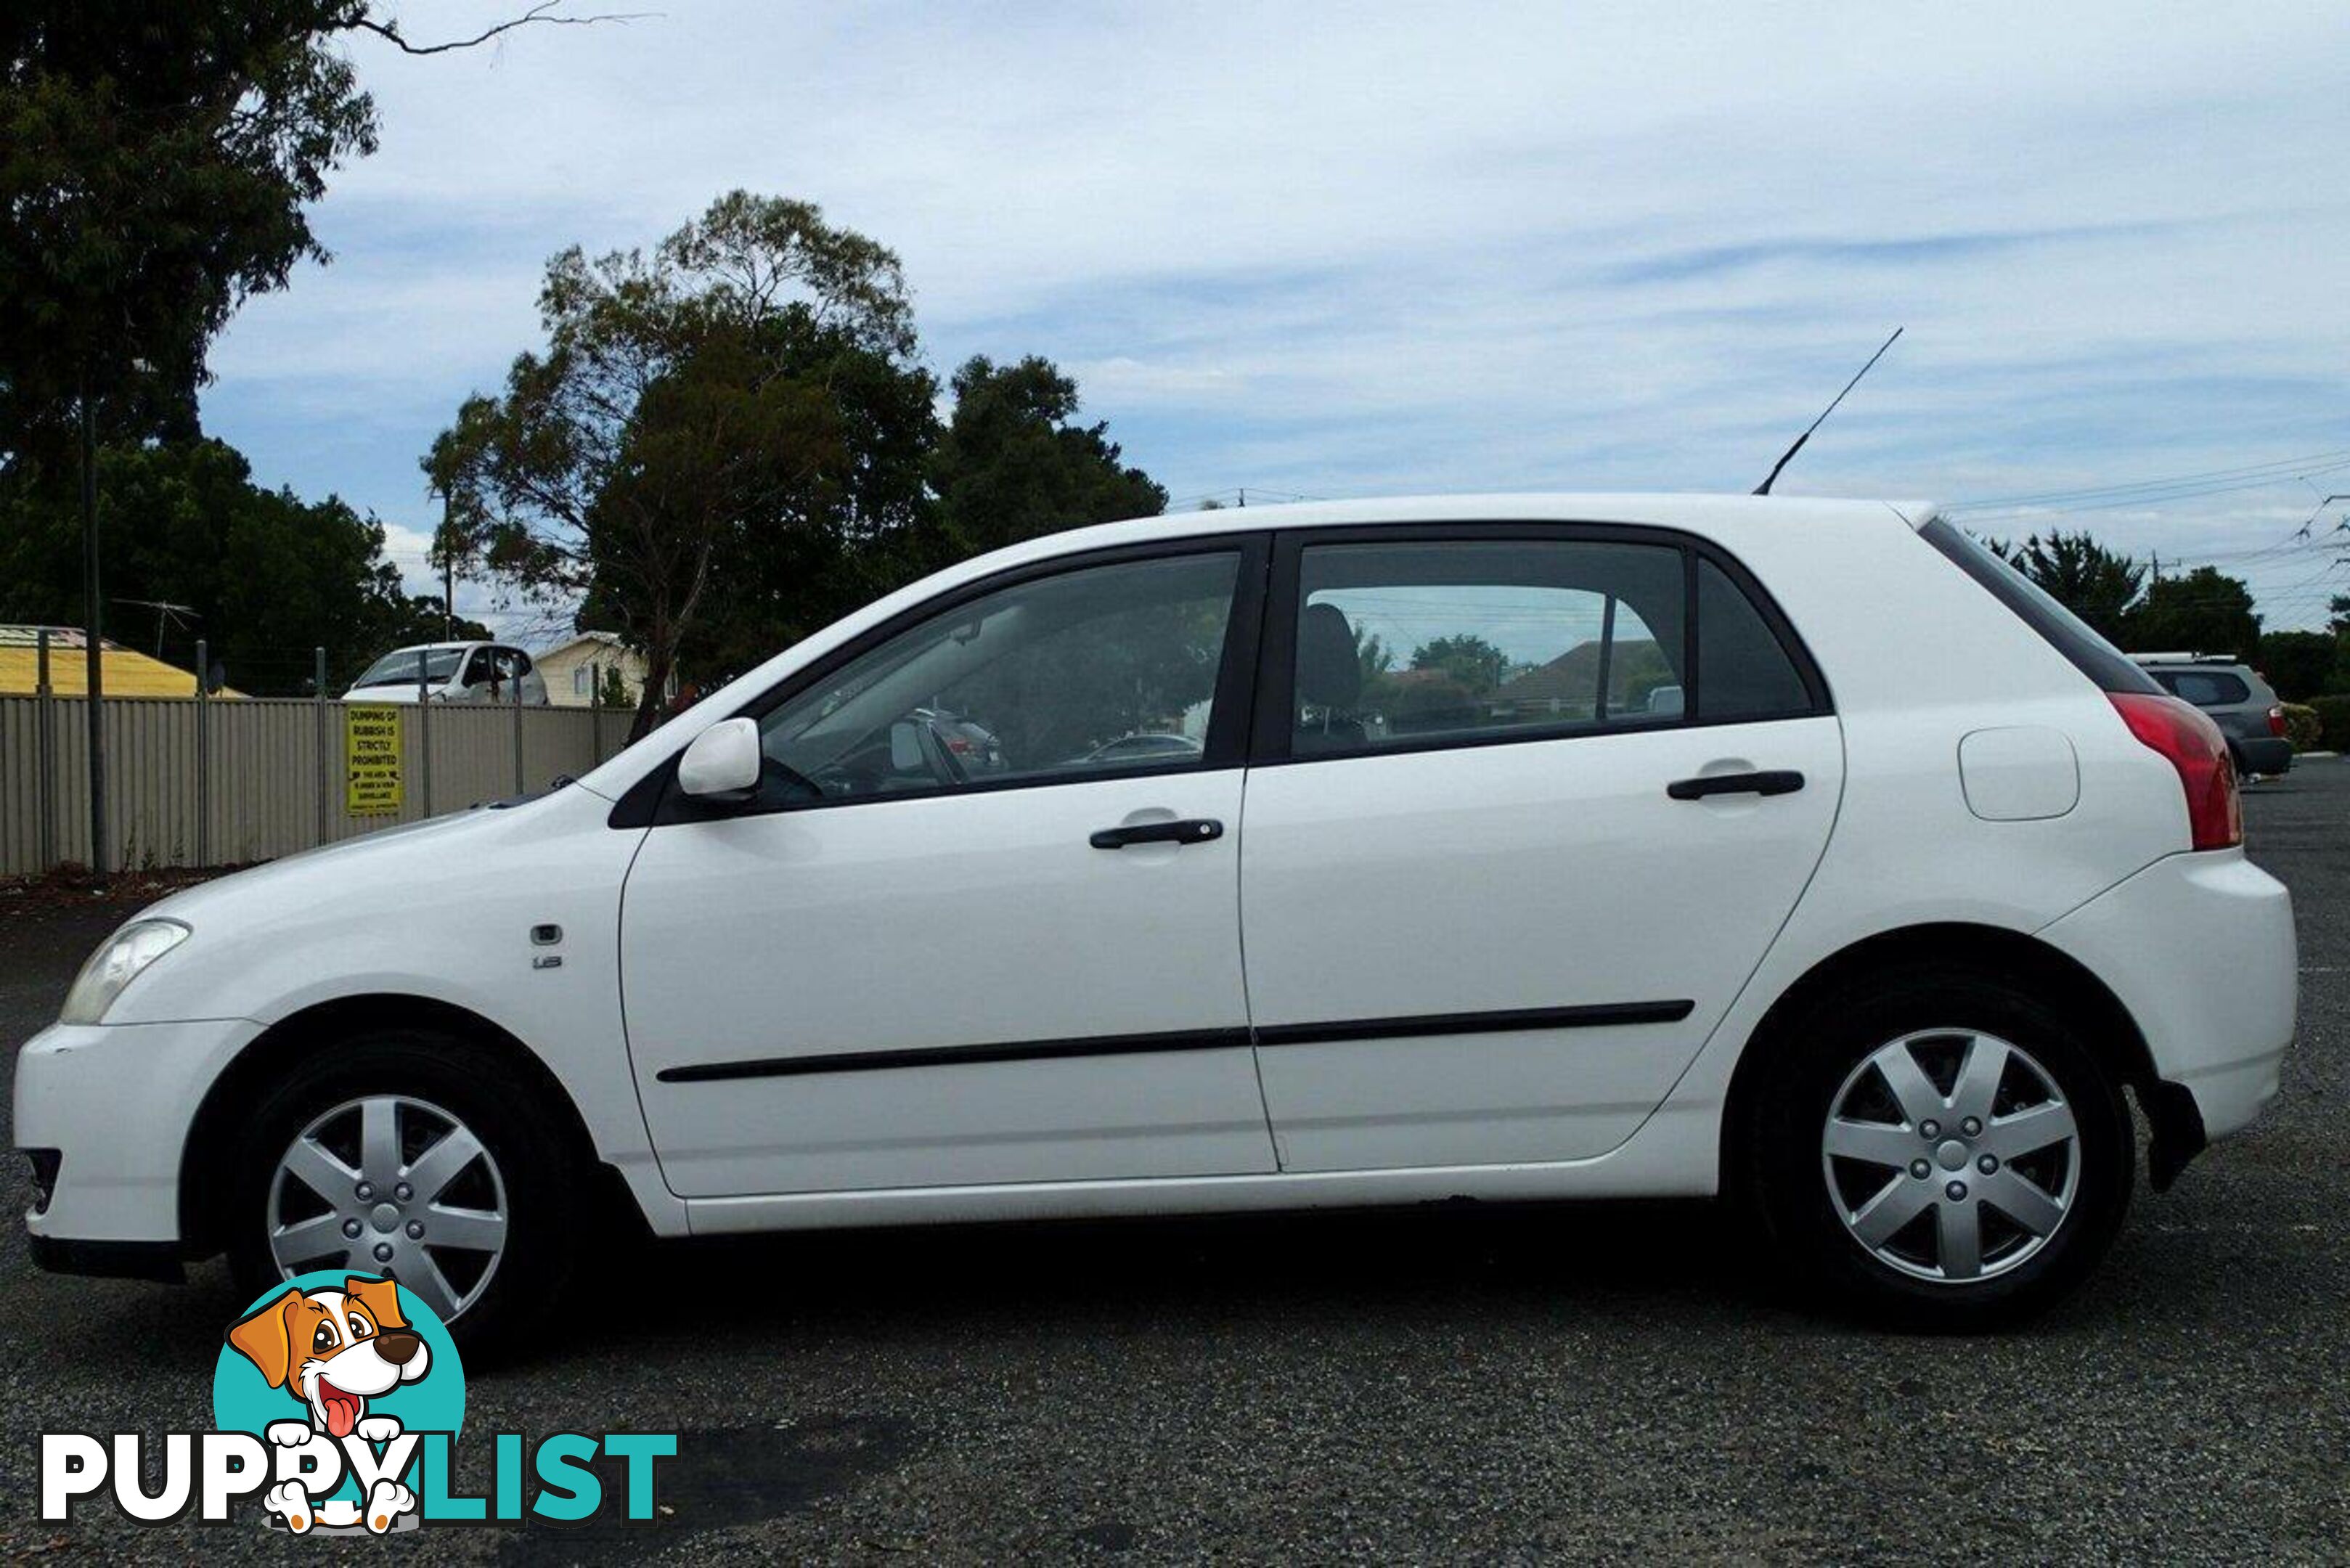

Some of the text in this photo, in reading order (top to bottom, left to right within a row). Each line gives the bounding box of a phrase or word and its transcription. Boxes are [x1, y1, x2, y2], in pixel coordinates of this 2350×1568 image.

[350, 711, 396, 721] DUMPING OF
[354, 727, 394, 736] RUBBISH IS
[357, 741, 390, 751] STRICTLY
[352, 756, 396, 765] PROHIBITED
